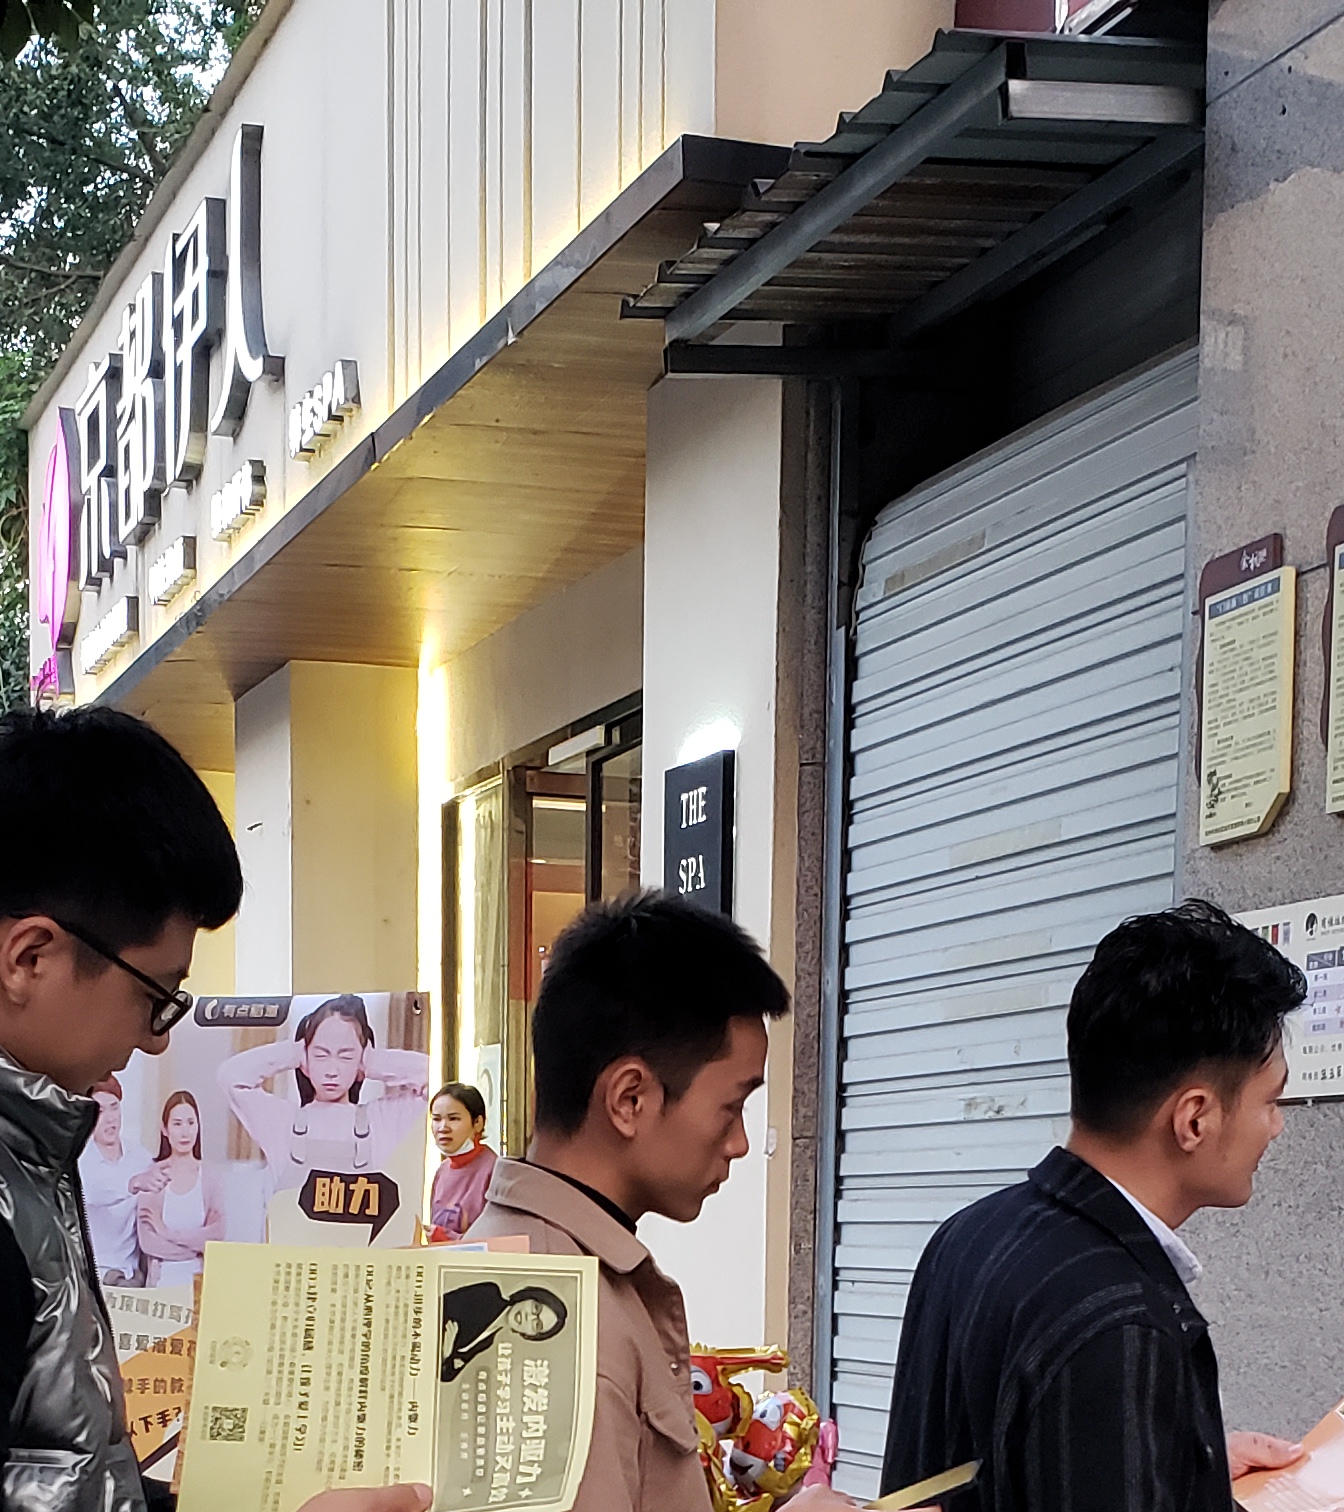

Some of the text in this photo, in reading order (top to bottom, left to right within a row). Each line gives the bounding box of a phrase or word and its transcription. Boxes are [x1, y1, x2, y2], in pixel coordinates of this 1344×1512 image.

[78, 122, 266, 592] 京都伊人
[680, 786, 708, 829] THE
[678, 854, 706, 895] SPA
[313, 1175, 381, 1217] 助力
[515, 1358, 550, 1486] 激发内驱力
